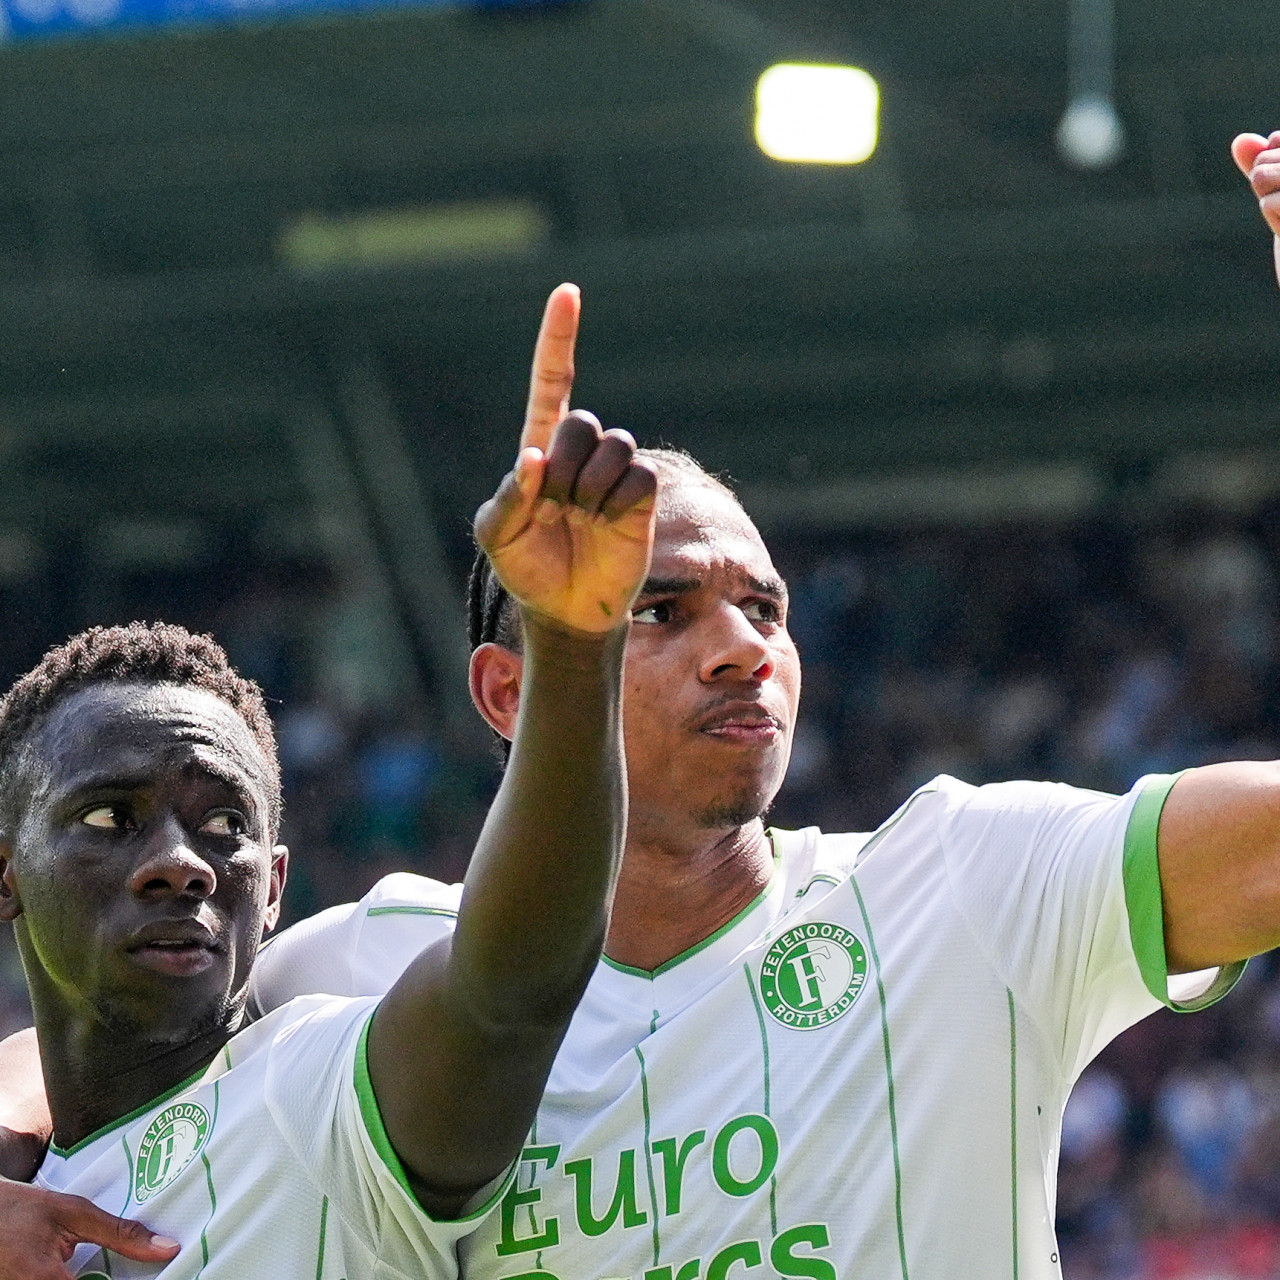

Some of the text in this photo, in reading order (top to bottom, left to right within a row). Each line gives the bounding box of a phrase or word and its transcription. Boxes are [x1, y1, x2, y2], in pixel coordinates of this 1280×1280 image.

[762, 924, 856, 978] FEYENOORD
[772, 972, 865, 1027] ROTTERDAM
[139, 1104, 206, 1159] FEYENOORD
[495, 1112, 780, 1258] Euro
